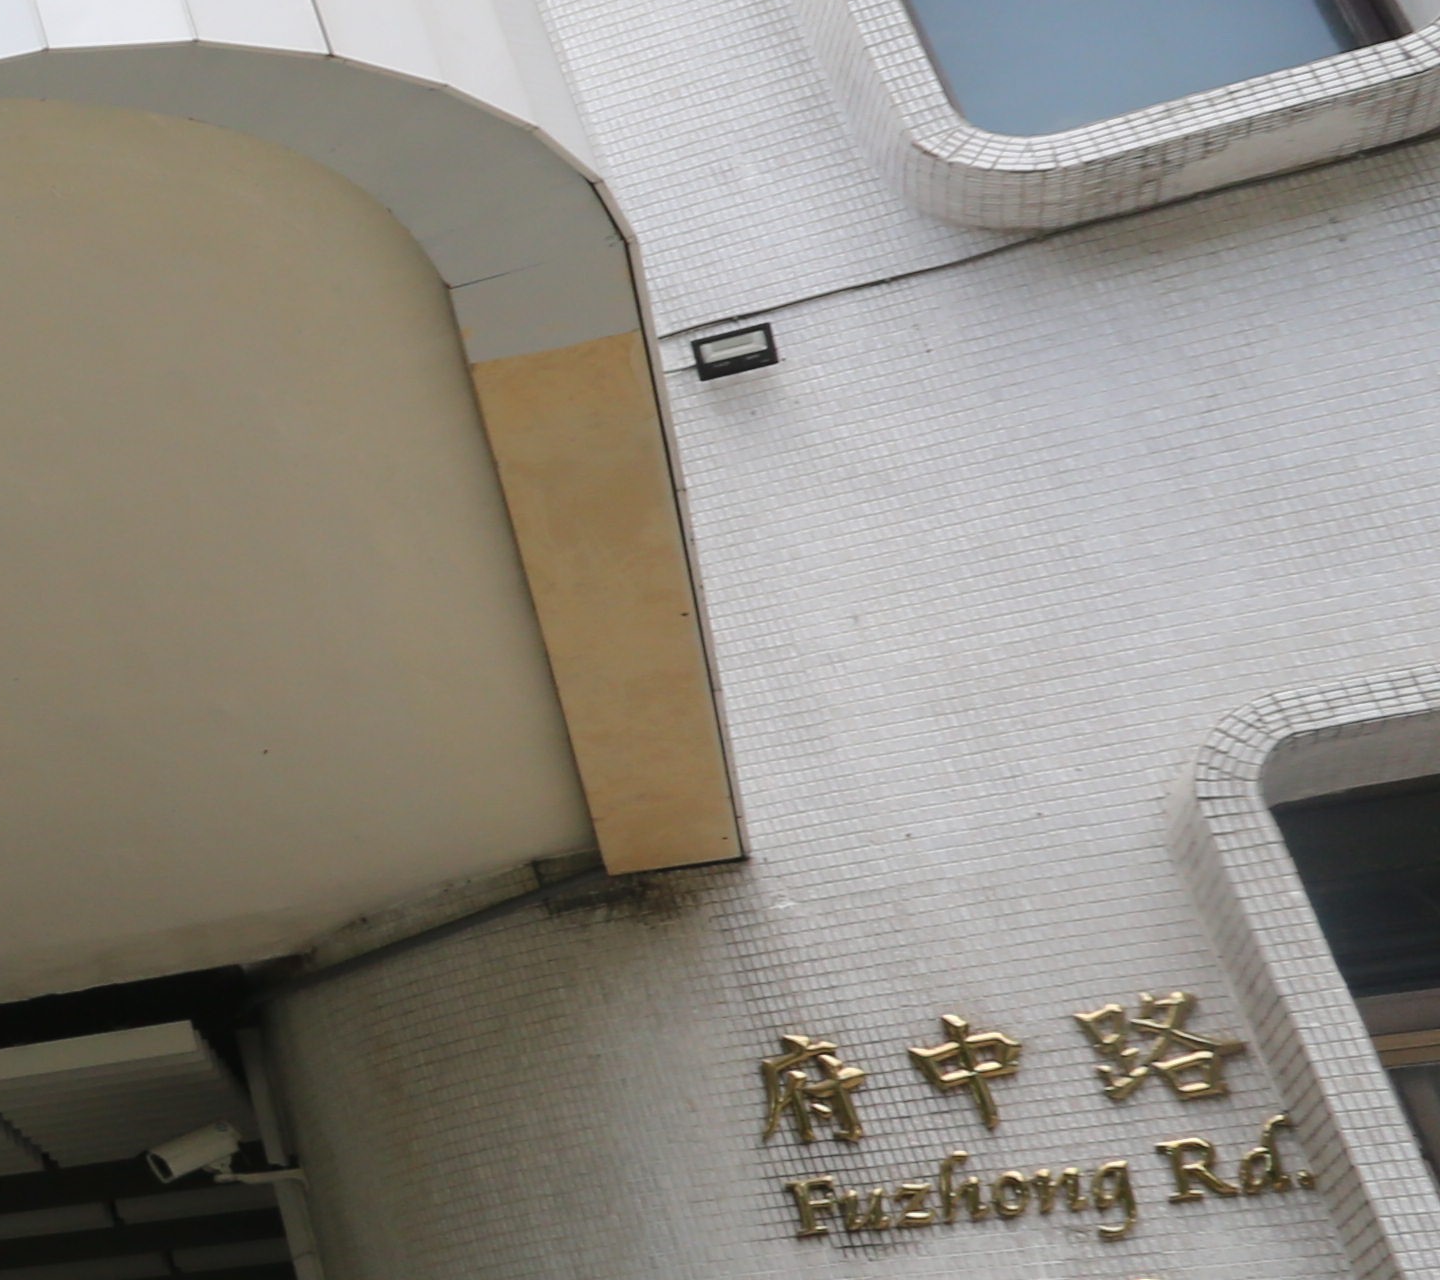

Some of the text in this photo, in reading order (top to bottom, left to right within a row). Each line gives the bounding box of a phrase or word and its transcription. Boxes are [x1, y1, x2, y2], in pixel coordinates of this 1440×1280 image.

[761, 991, 1246, 1144] 府中路
[786, 1113, 1316, 1241] Fuzhong Rd.
